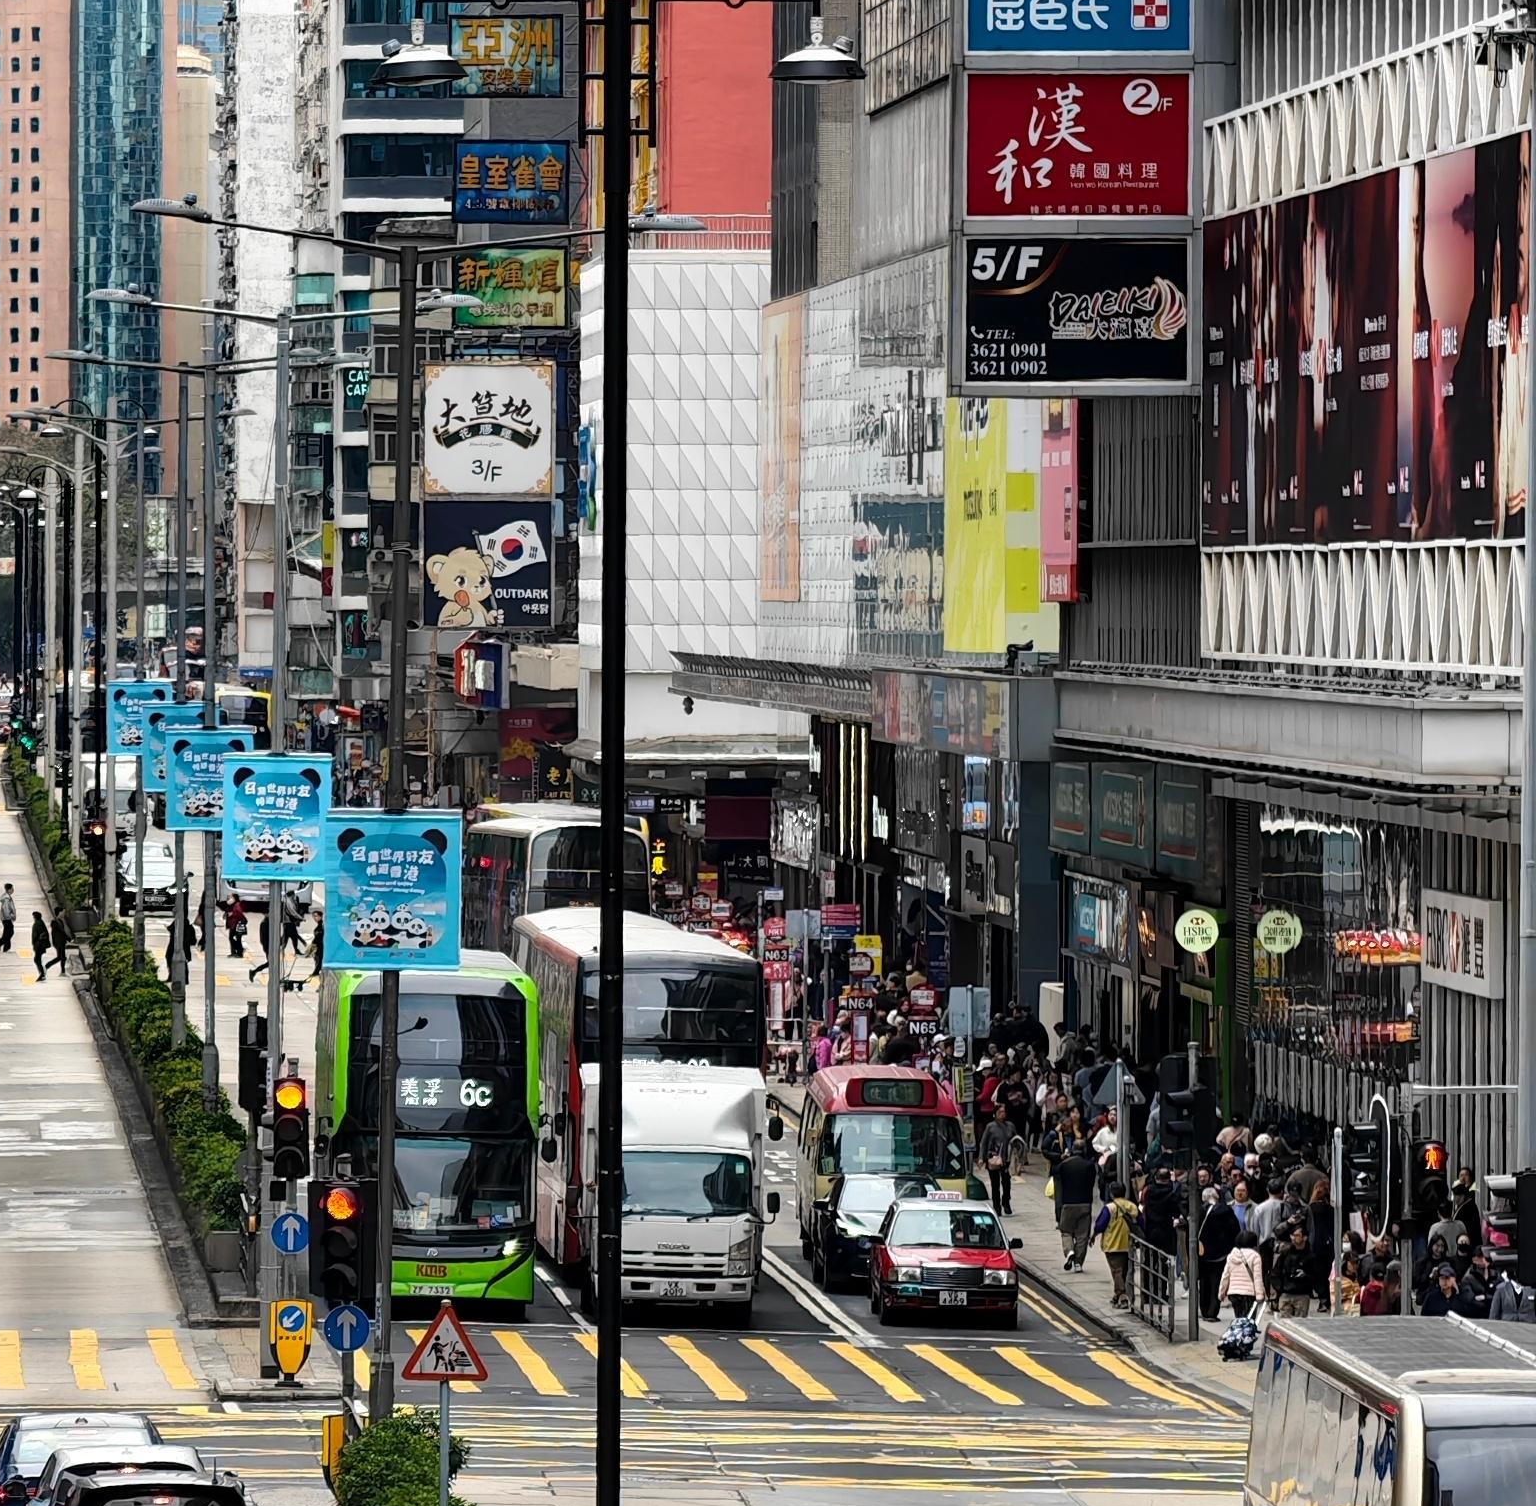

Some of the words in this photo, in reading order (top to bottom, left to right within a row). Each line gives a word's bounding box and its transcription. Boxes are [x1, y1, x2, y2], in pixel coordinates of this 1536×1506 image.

[459, 18, 554, 67] 亞洲
[458, 154, 564, 191] 皇室雀會
[972, 246, 1043, 281] 5/F
[986, 329, 1016, 340] TEL:
[971, 343, 1005, 357] 3621
[1011, 343, 1046, 357] 0901
[971, 361, 1005, 375] 3621
[1011, 361, 1047, 375] 0902
[471, 459, 502, 482] 3/F
[495, 588, 548, 599] OUTDARK
[1183, 927, 1212, 936] HSBC
[765, 950, 787, 961] N63
[849, 998, 873, 1009] N64
[909, 1022, 936, 1035] N65
[416, 1264, 447, 1278] KMB
